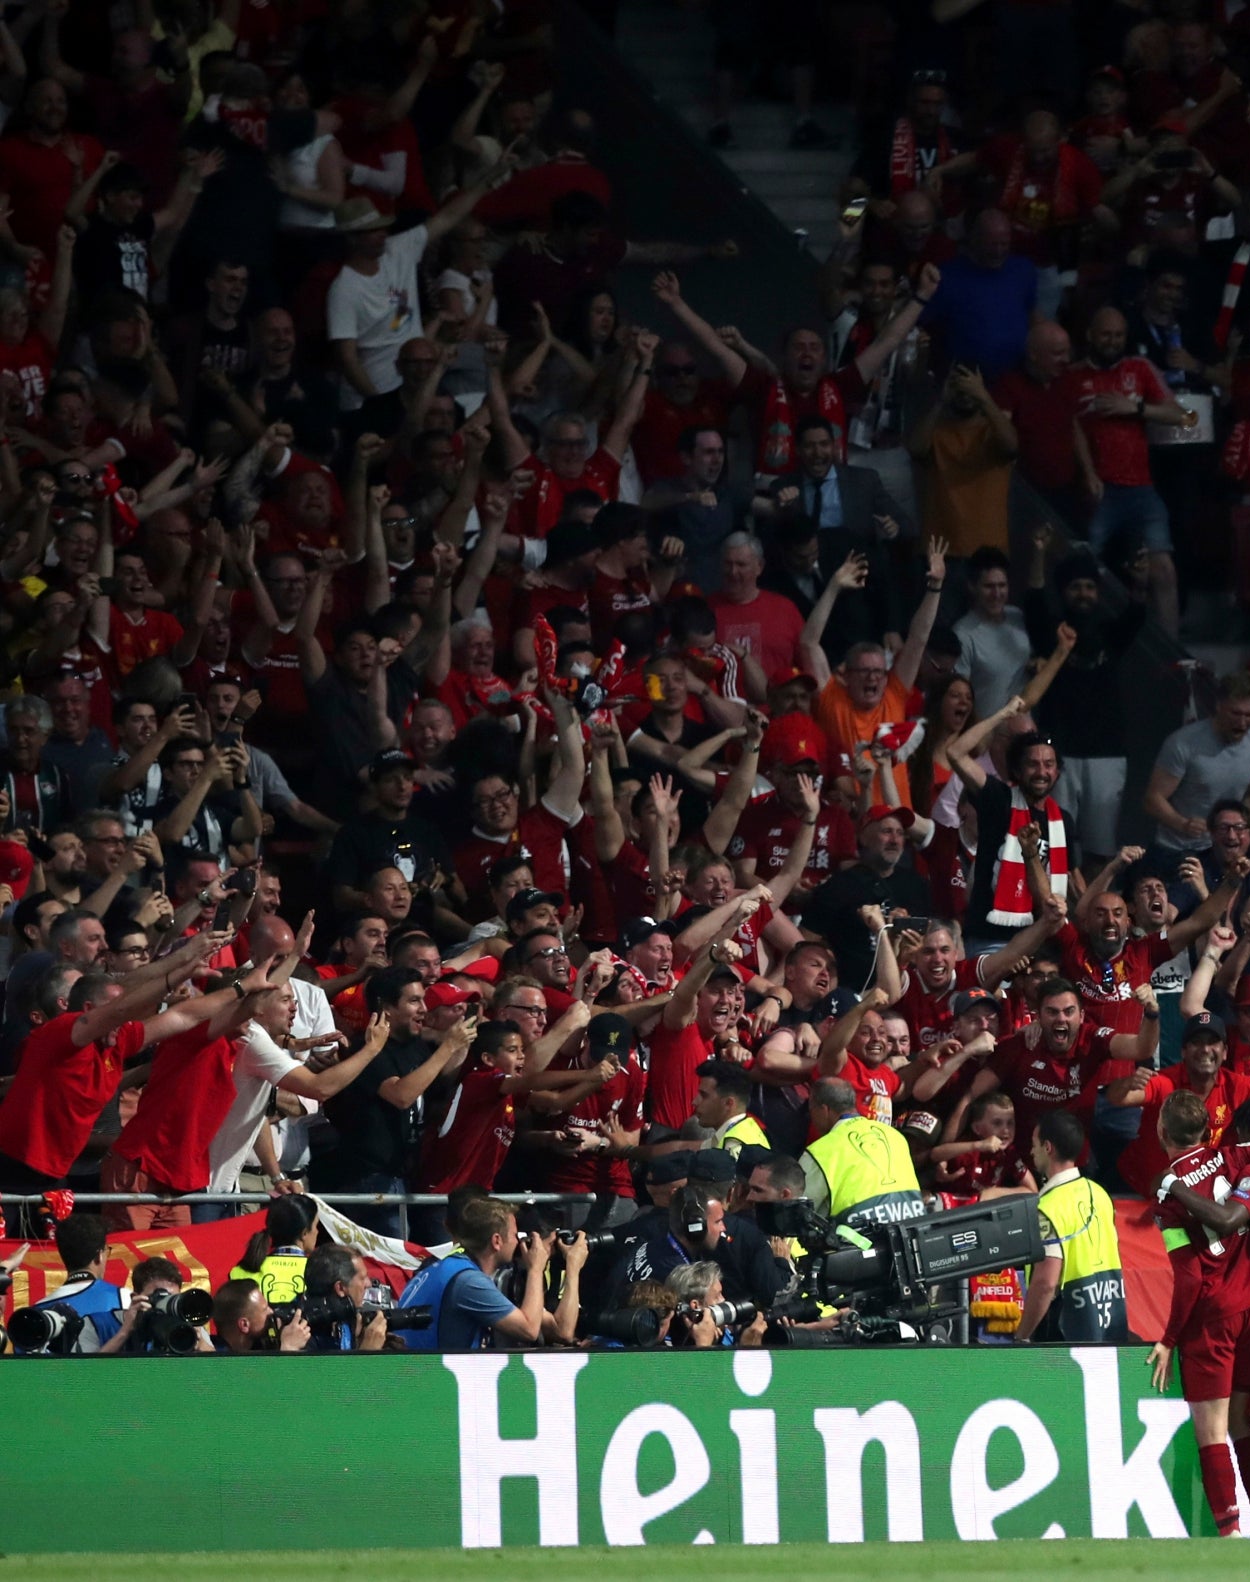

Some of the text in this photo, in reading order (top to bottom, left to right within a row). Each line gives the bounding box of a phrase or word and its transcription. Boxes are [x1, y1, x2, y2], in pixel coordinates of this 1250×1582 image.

[951, 1230, 979, 1247] ES
[929, 1254, 960, 1269] DIGISUPER
[960, 1253, 970, 1263] 95
[976, 1285, 1014, 1296] ANFIELD
